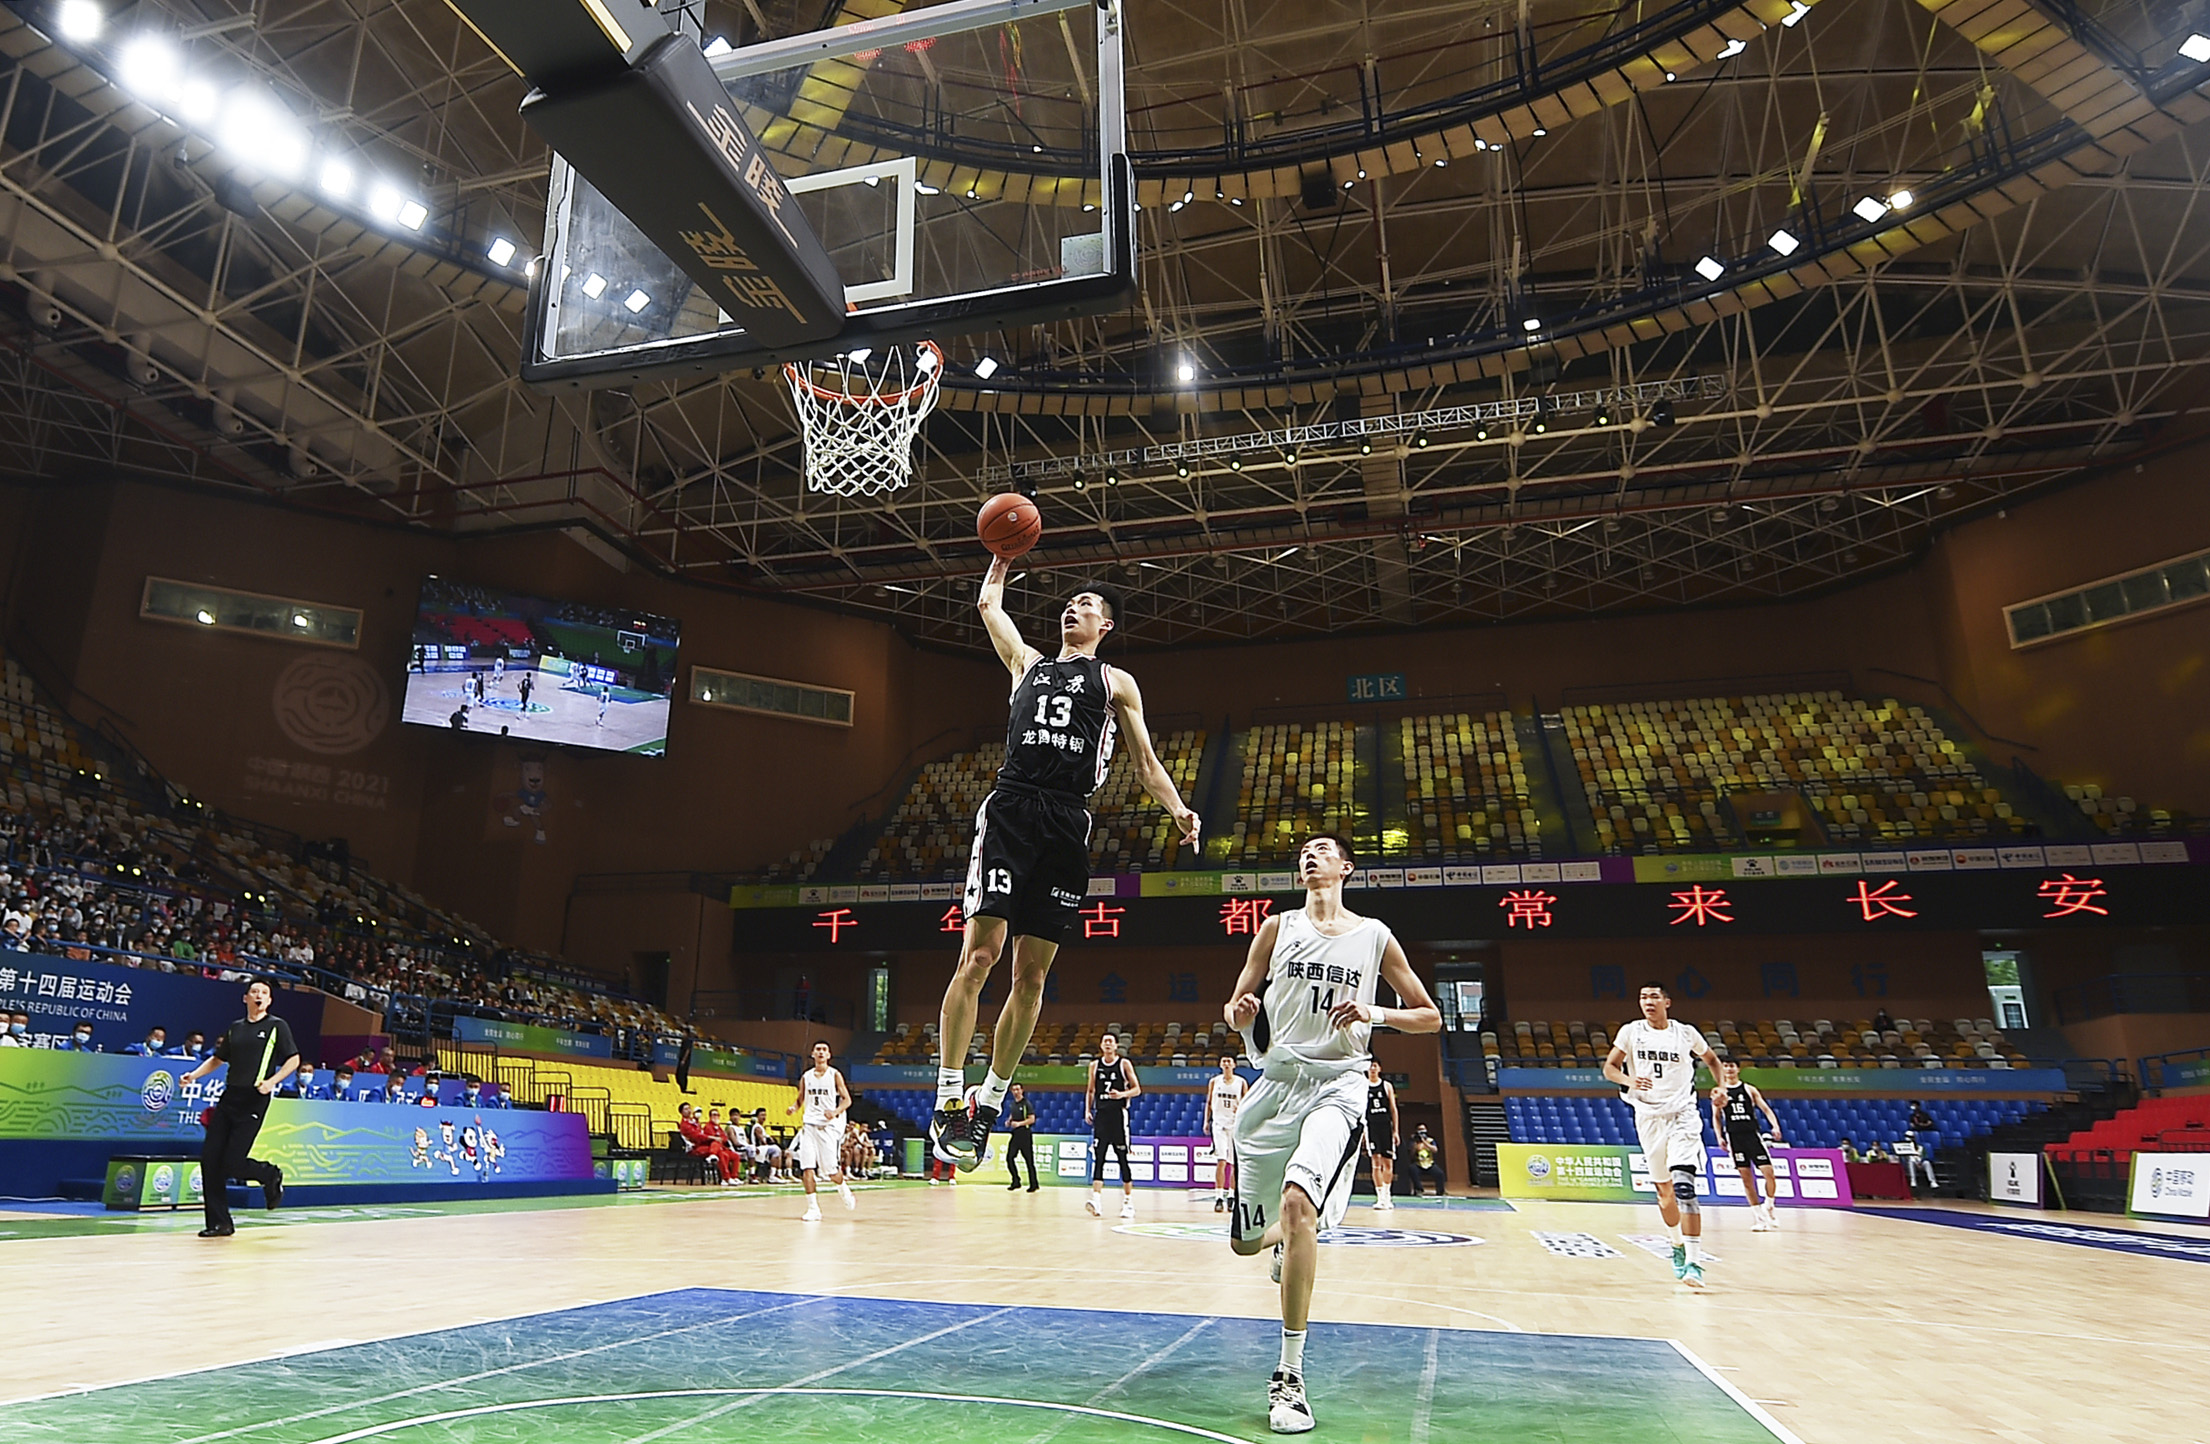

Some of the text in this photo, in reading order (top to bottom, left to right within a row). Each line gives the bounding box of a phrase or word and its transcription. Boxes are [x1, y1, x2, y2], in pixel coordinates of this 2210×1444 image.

[1351, 676, 1401, 699] 北区
[1034, 694, 1073, 727] 13
[337, 769, 389, 794] 2021
[987, 868, 1013, 895] 13
[1287, 961, 1362, 988] 陕西信达
[0, 967, 133, 1006] 第十四届运动会
[1311, 986, 1335, 1014] 14
[28, 1001, 80, 1018] REPUBLIC
[80, 1007, 96, 1019] OF
[96, 1008, 128, 1023] CHINA
[1637, 1050, 1680, 1063] 陕西信达
[1653, 1063, 1663, 1078] 9
[181, 1079, 225, 1107] 中华
[1104, 1081, 1112, 1093] 7
[1373, 1098, 1381, 1108] 6
[1731, 1102, 1745, 1114] 16
[178, 1111, 202, 1125] THE
[1555, 1156, 1622, 1167] 中华人民共和国
[1556, 1166, 1622, 1177] 第十四届运动会
[1241, 1203, 1266, 1231] 14
